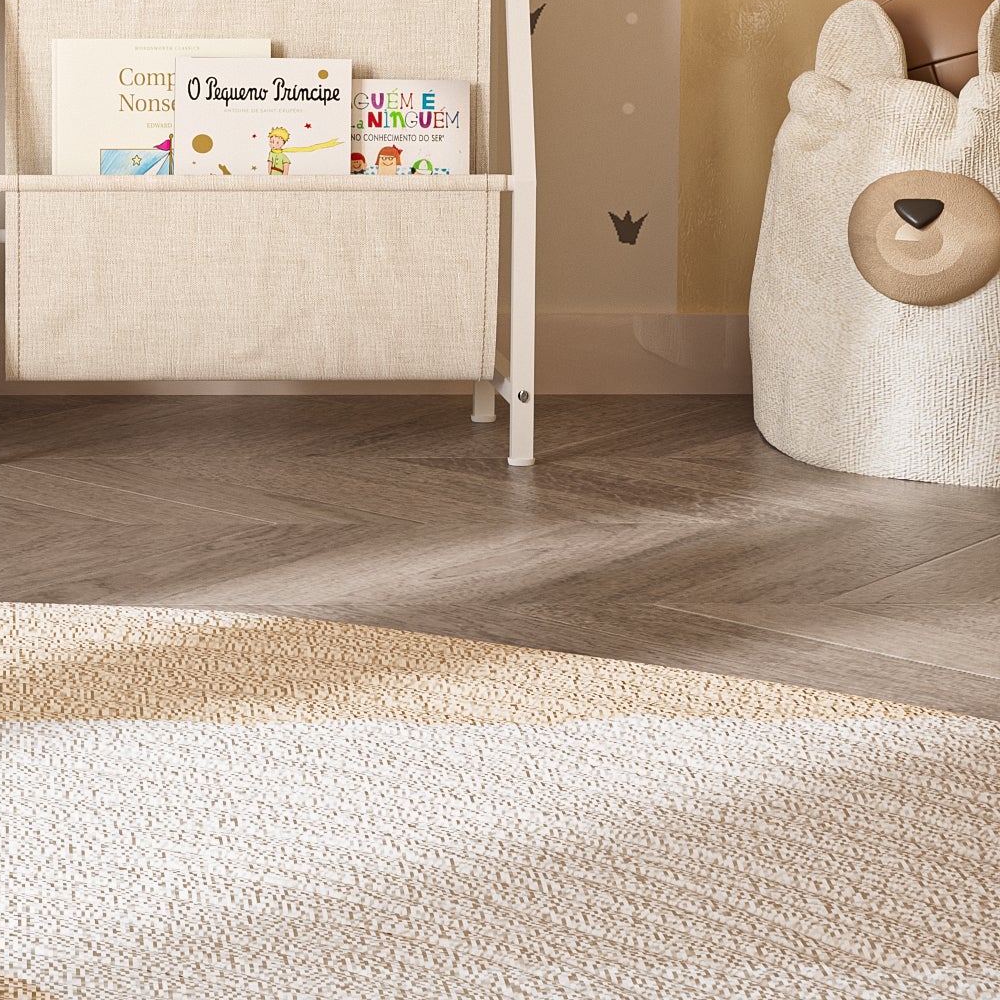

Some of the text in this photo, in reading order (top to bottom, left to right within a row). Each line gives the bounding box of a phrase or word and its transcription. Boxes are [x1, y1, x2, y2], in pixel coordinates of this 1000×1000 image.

[187, 76, 340, 107] O Pequeno Príncipe
[422, 90, 435, 110] É
[363, 134, 417, 142] CONHECIMENTO
[419, 134, 430, 142] DO
